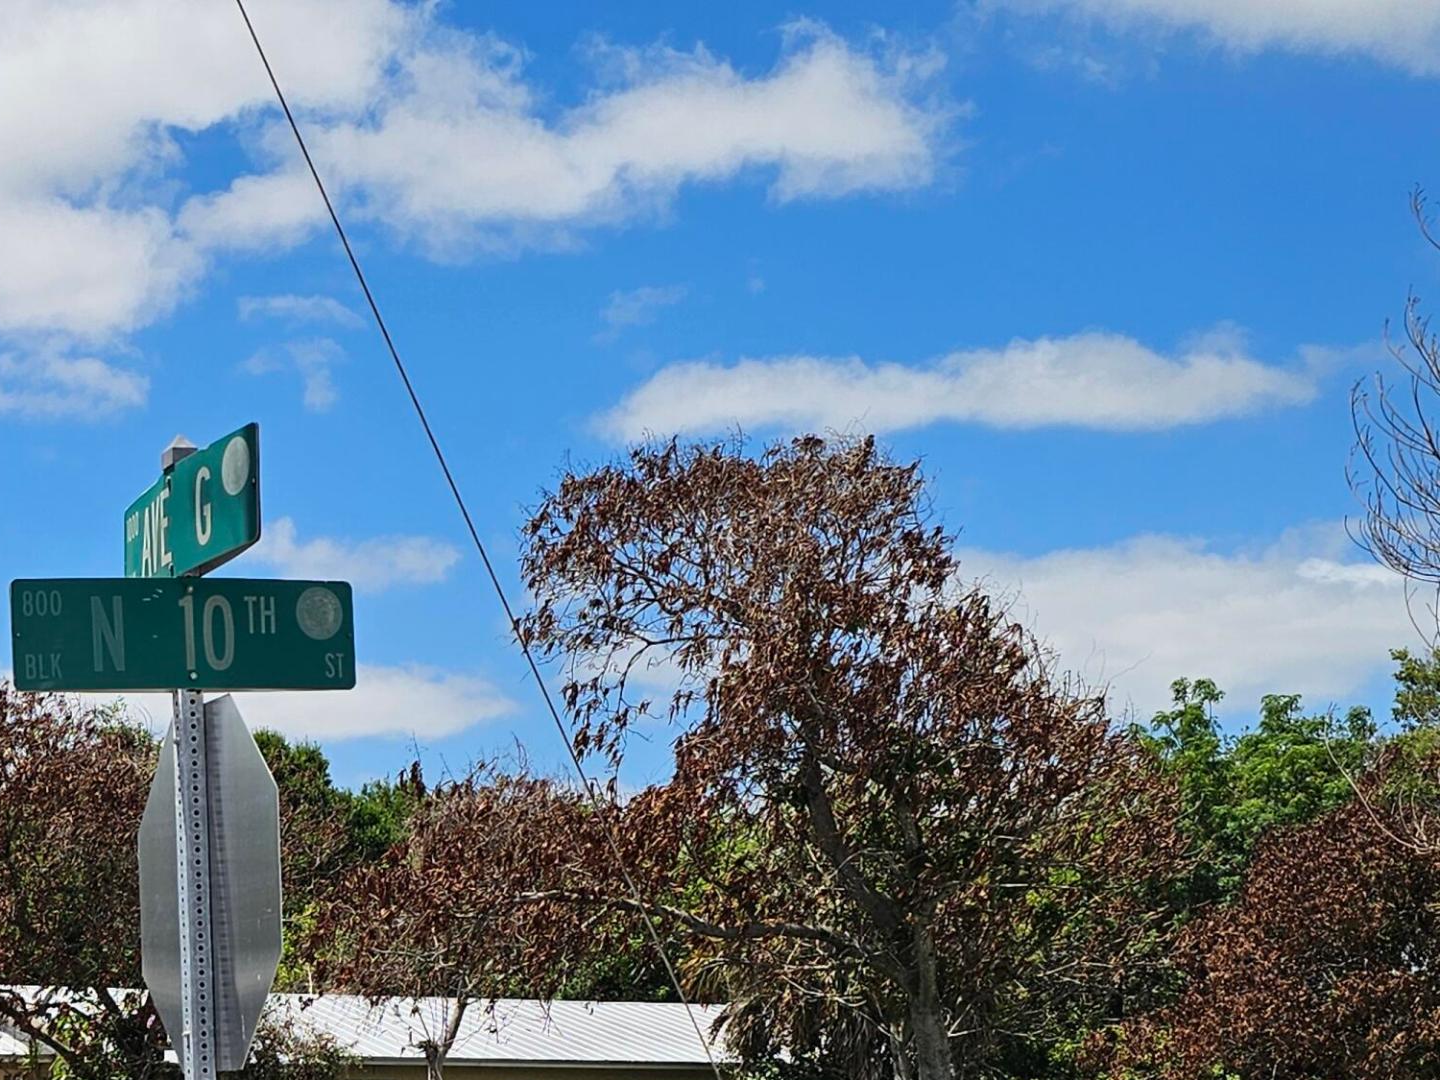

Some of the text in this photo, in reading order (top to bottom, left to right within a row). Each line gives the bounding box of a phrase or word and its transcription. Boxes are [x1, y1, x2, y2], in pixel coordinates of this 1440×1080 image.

[141, 466, 211, 578] AVE G
[22, 590, 61, 616] 800
[90, 595, 126, 672] N
[24, 653, 62, 680] BLK
[324, 652, 345, 679] ST
